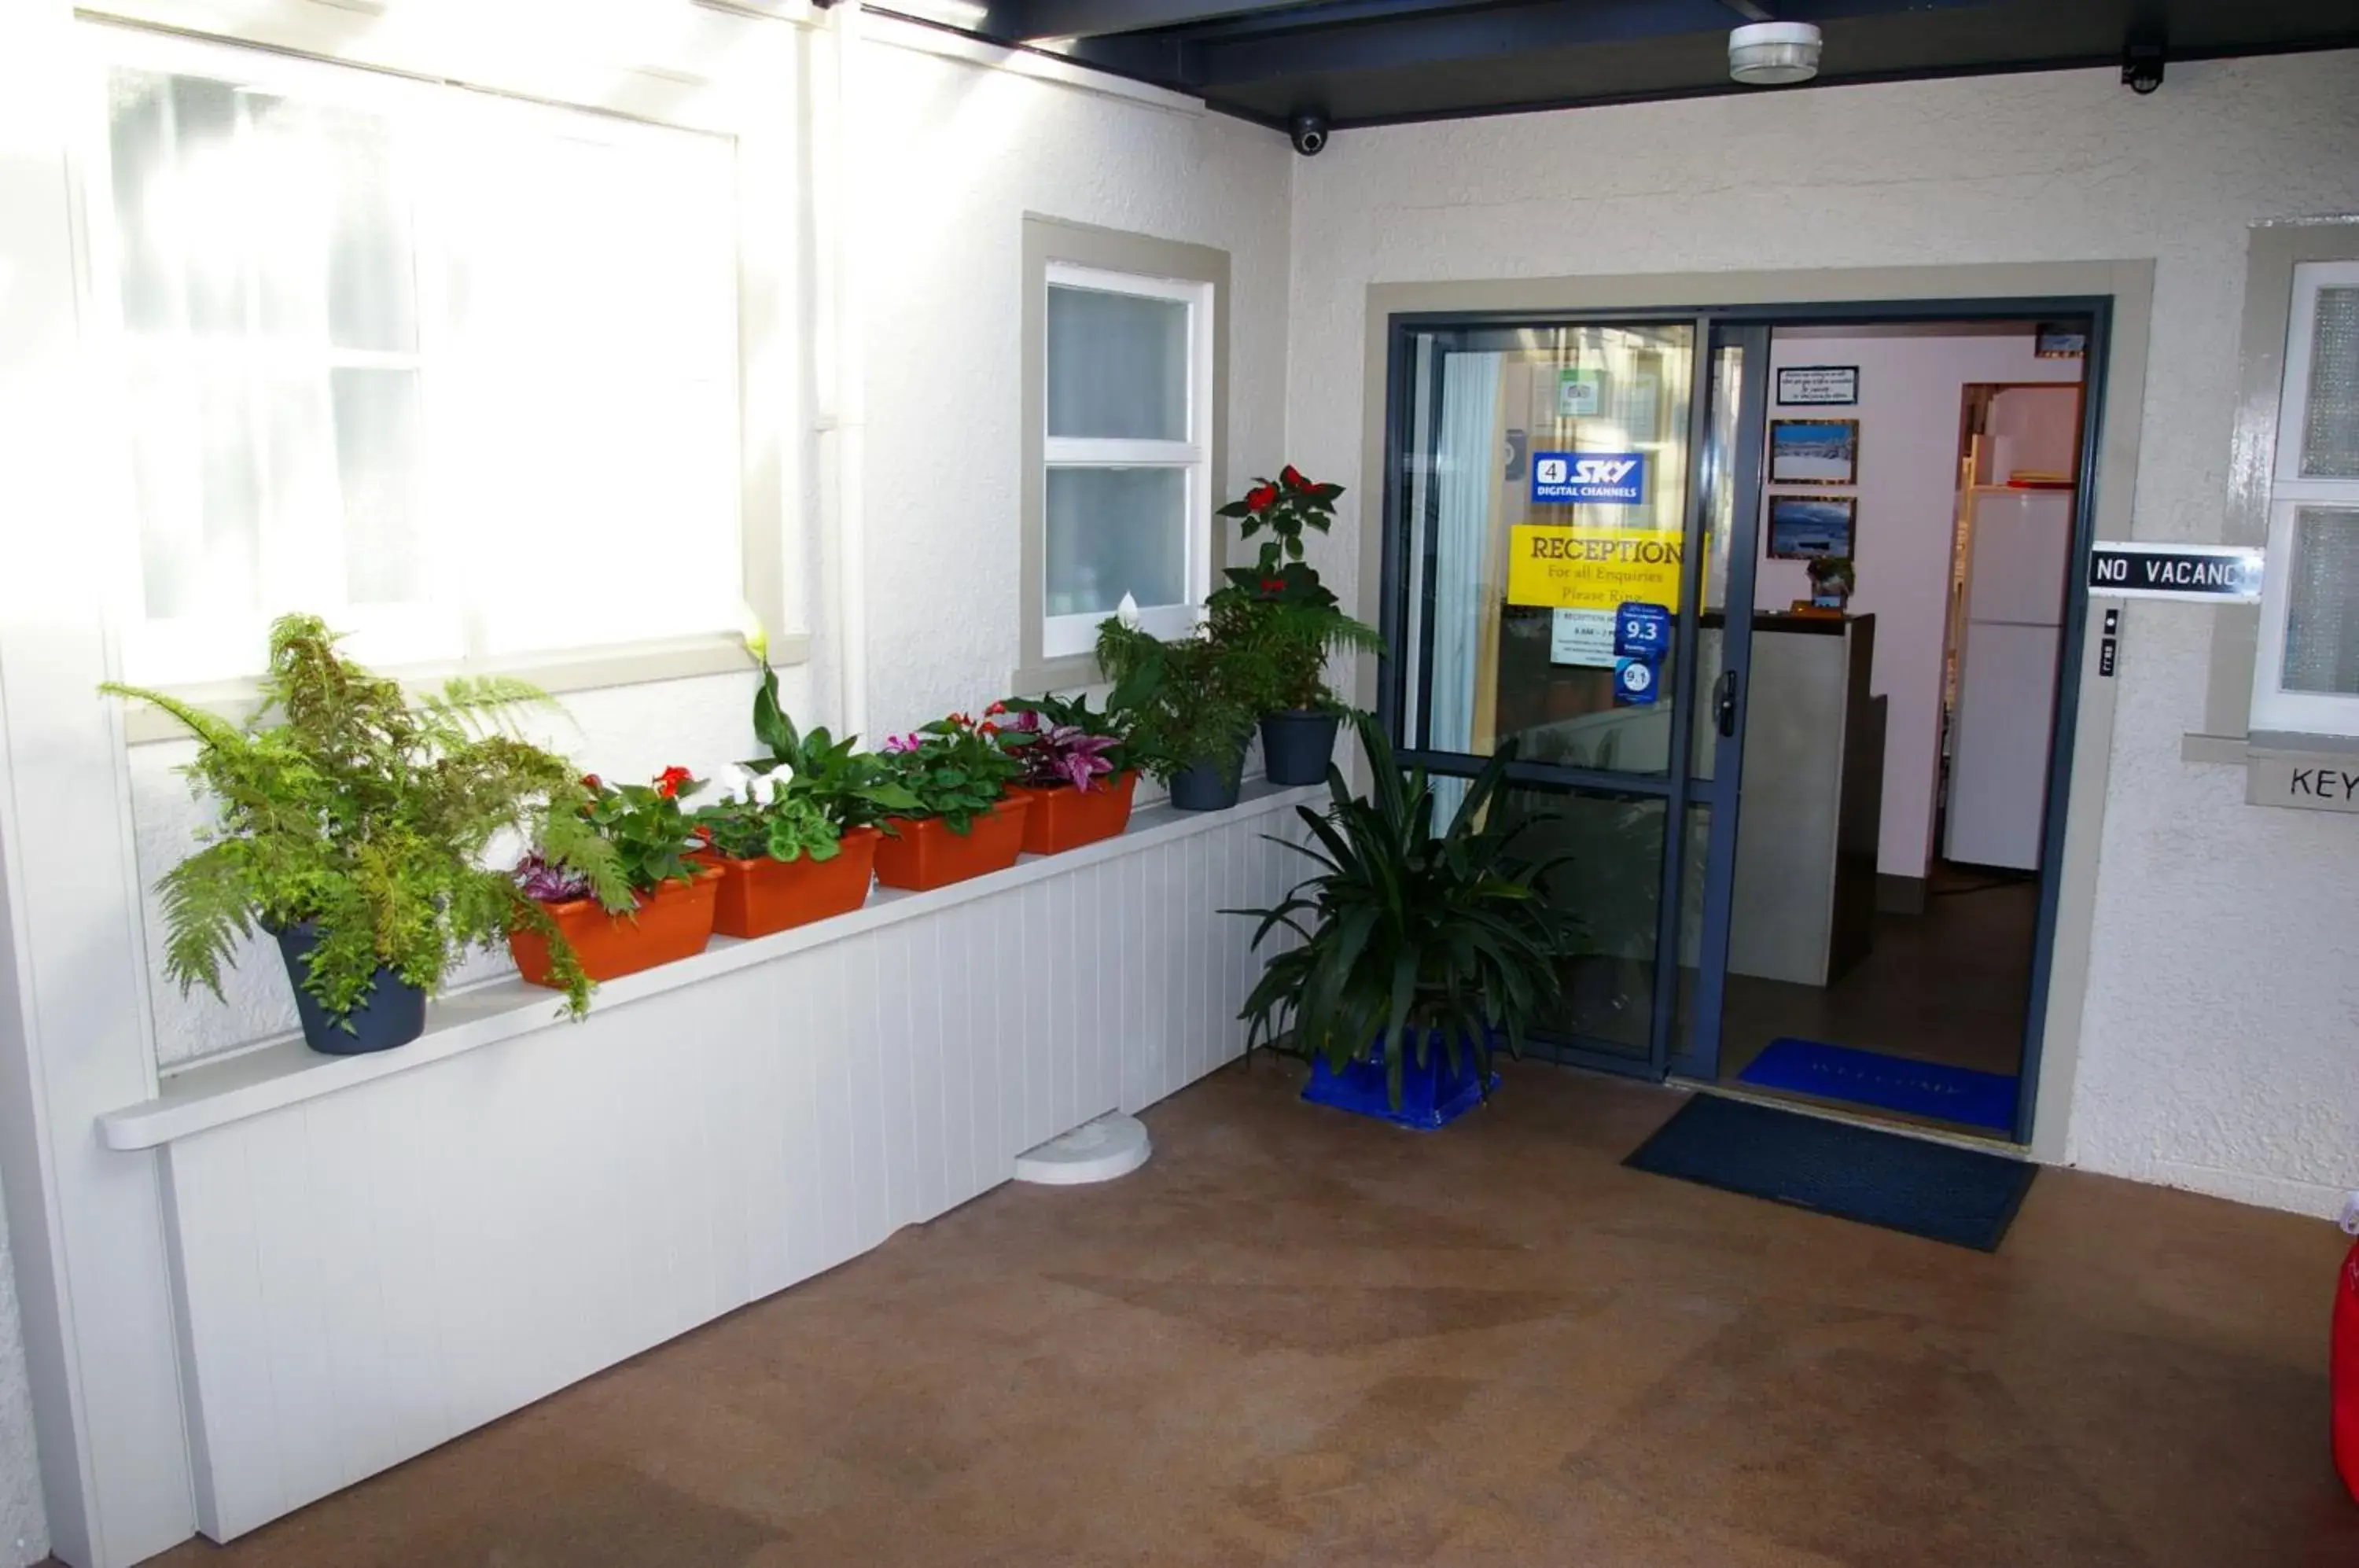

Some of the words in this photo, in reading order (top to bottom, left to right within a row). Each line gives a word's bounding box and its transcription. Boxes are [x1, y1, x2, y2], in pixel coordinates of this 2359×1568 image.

[1544, 462, 1557, 480] 4
[1570, 459, 1638, 484] SKY
[1537, 485, 1579, 496] DIGITAL
[1580, 486, 1637, 498] CHANNELS
[1530, 536, 1685, 565] RECEPTION
[1548, 565, 1570, 578] For
[1574, 565, 1591, 579] all
[1596, 566, 1664, 584] Enquiries
[2096, 558, 2128, 581] NO
[2146, 560, 2243, 586] VACANC
[1562, 587, 1605, 602] Please
[1626, 620, 1658, 640] 9.3
[1626, 670, 1647, 683] 9.1
[2291, 767, 2359, 801] KEY
